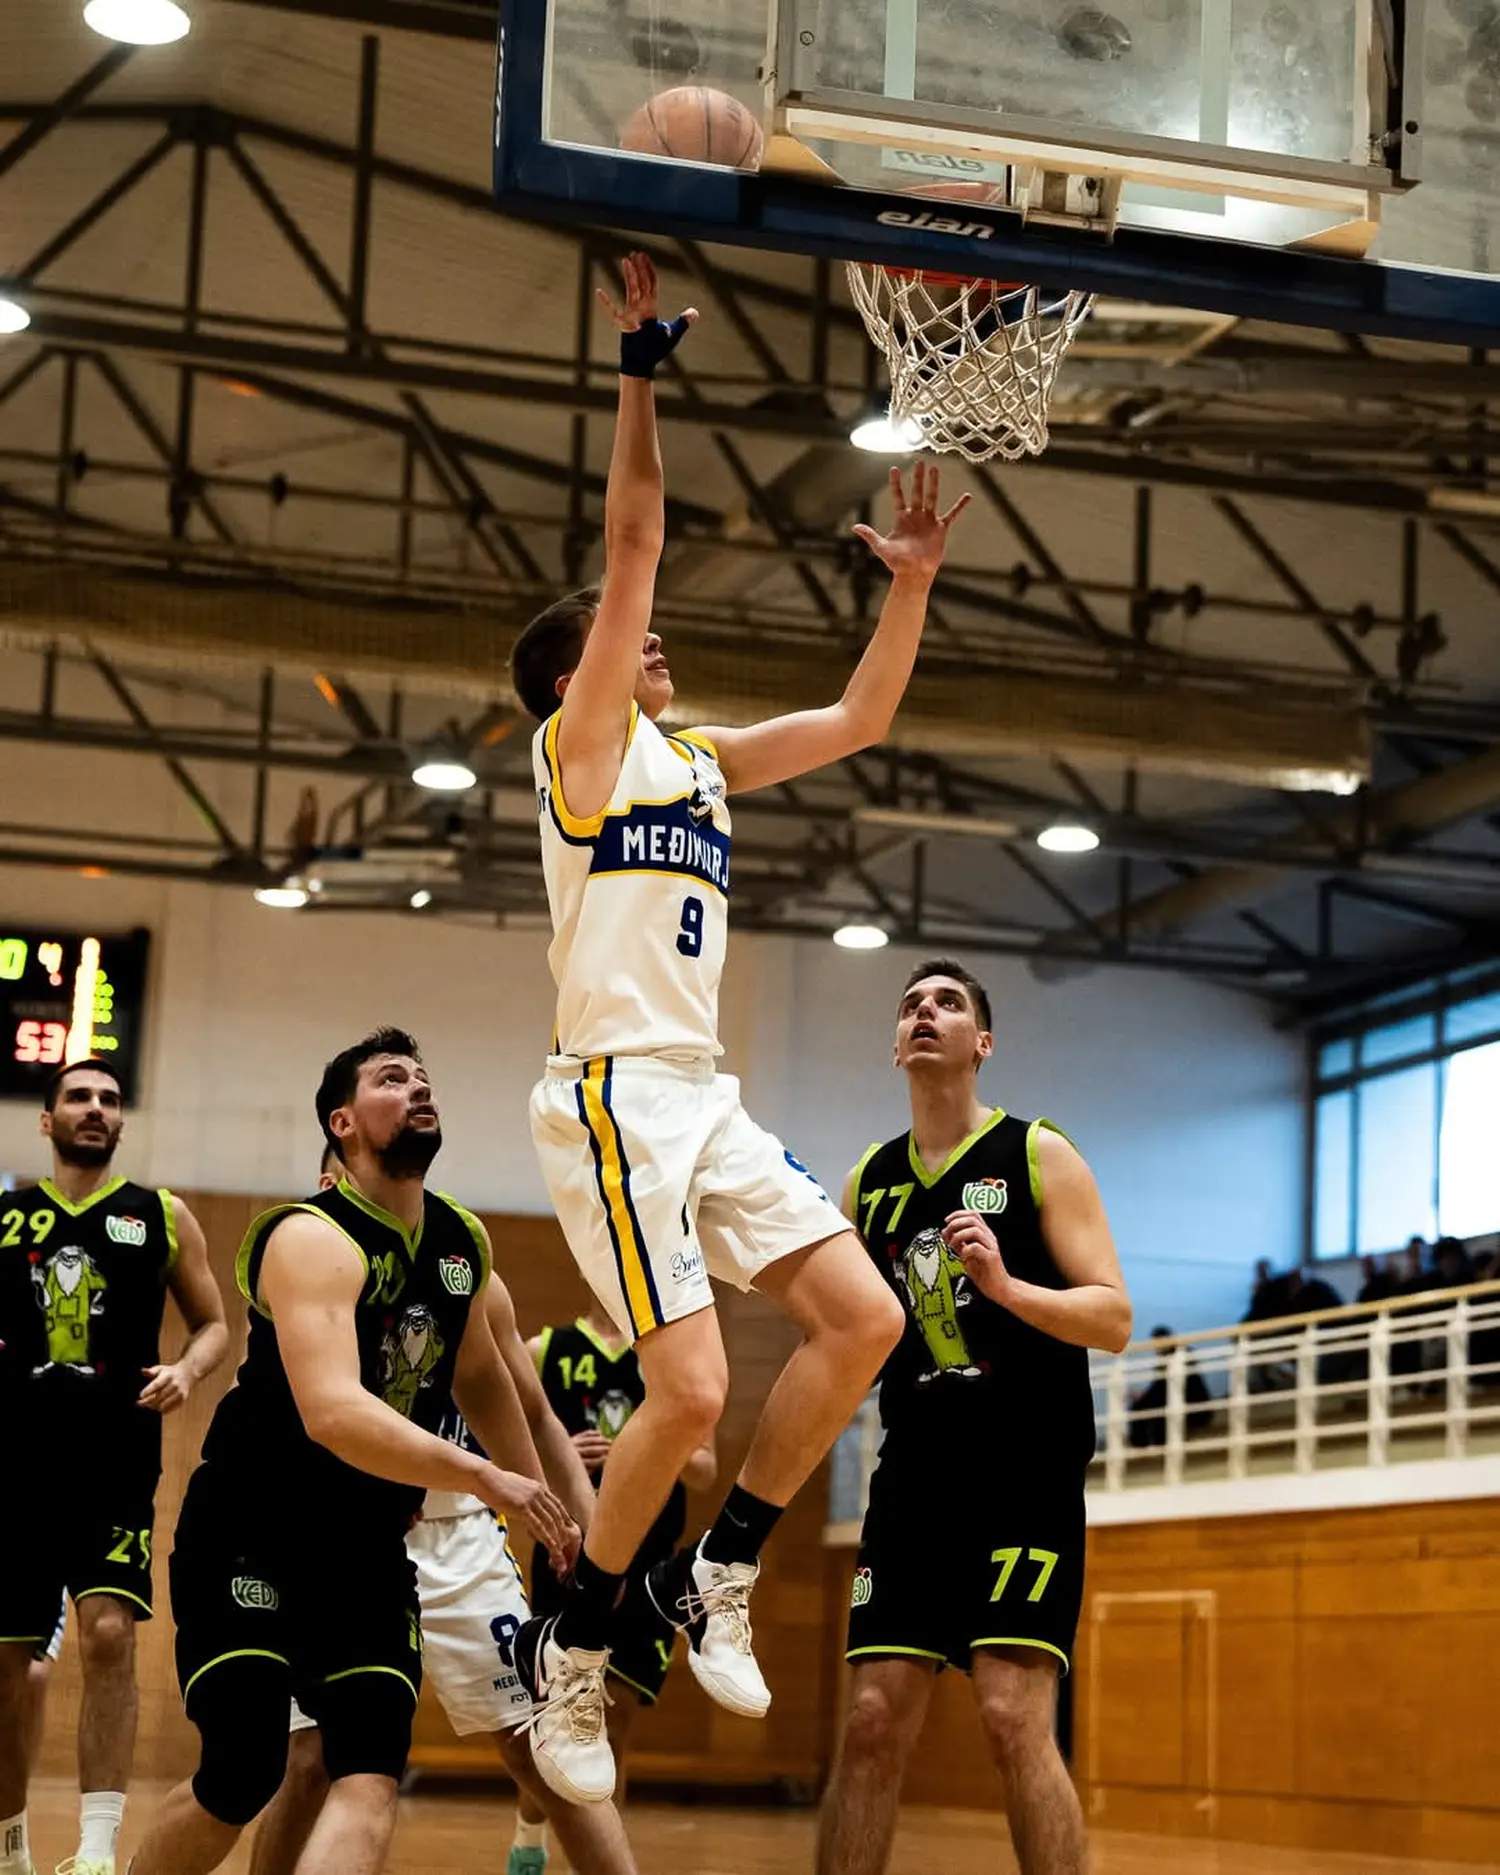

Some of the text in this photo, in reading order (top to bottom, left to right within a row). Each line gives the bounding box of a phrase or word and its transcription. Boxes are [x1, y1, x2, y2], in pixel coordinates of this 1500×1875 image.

[877, 210, 995, 239] elan
[675, 895, 704, 958] 9
[15, 1020, 66, 1064] 53
[0, 1209, 56, 1247] 29
[861, 1182, 915, 1241] 77
[558, 1352, 598, 1390] 14
[989, 1547, 1059, 1602] 77
